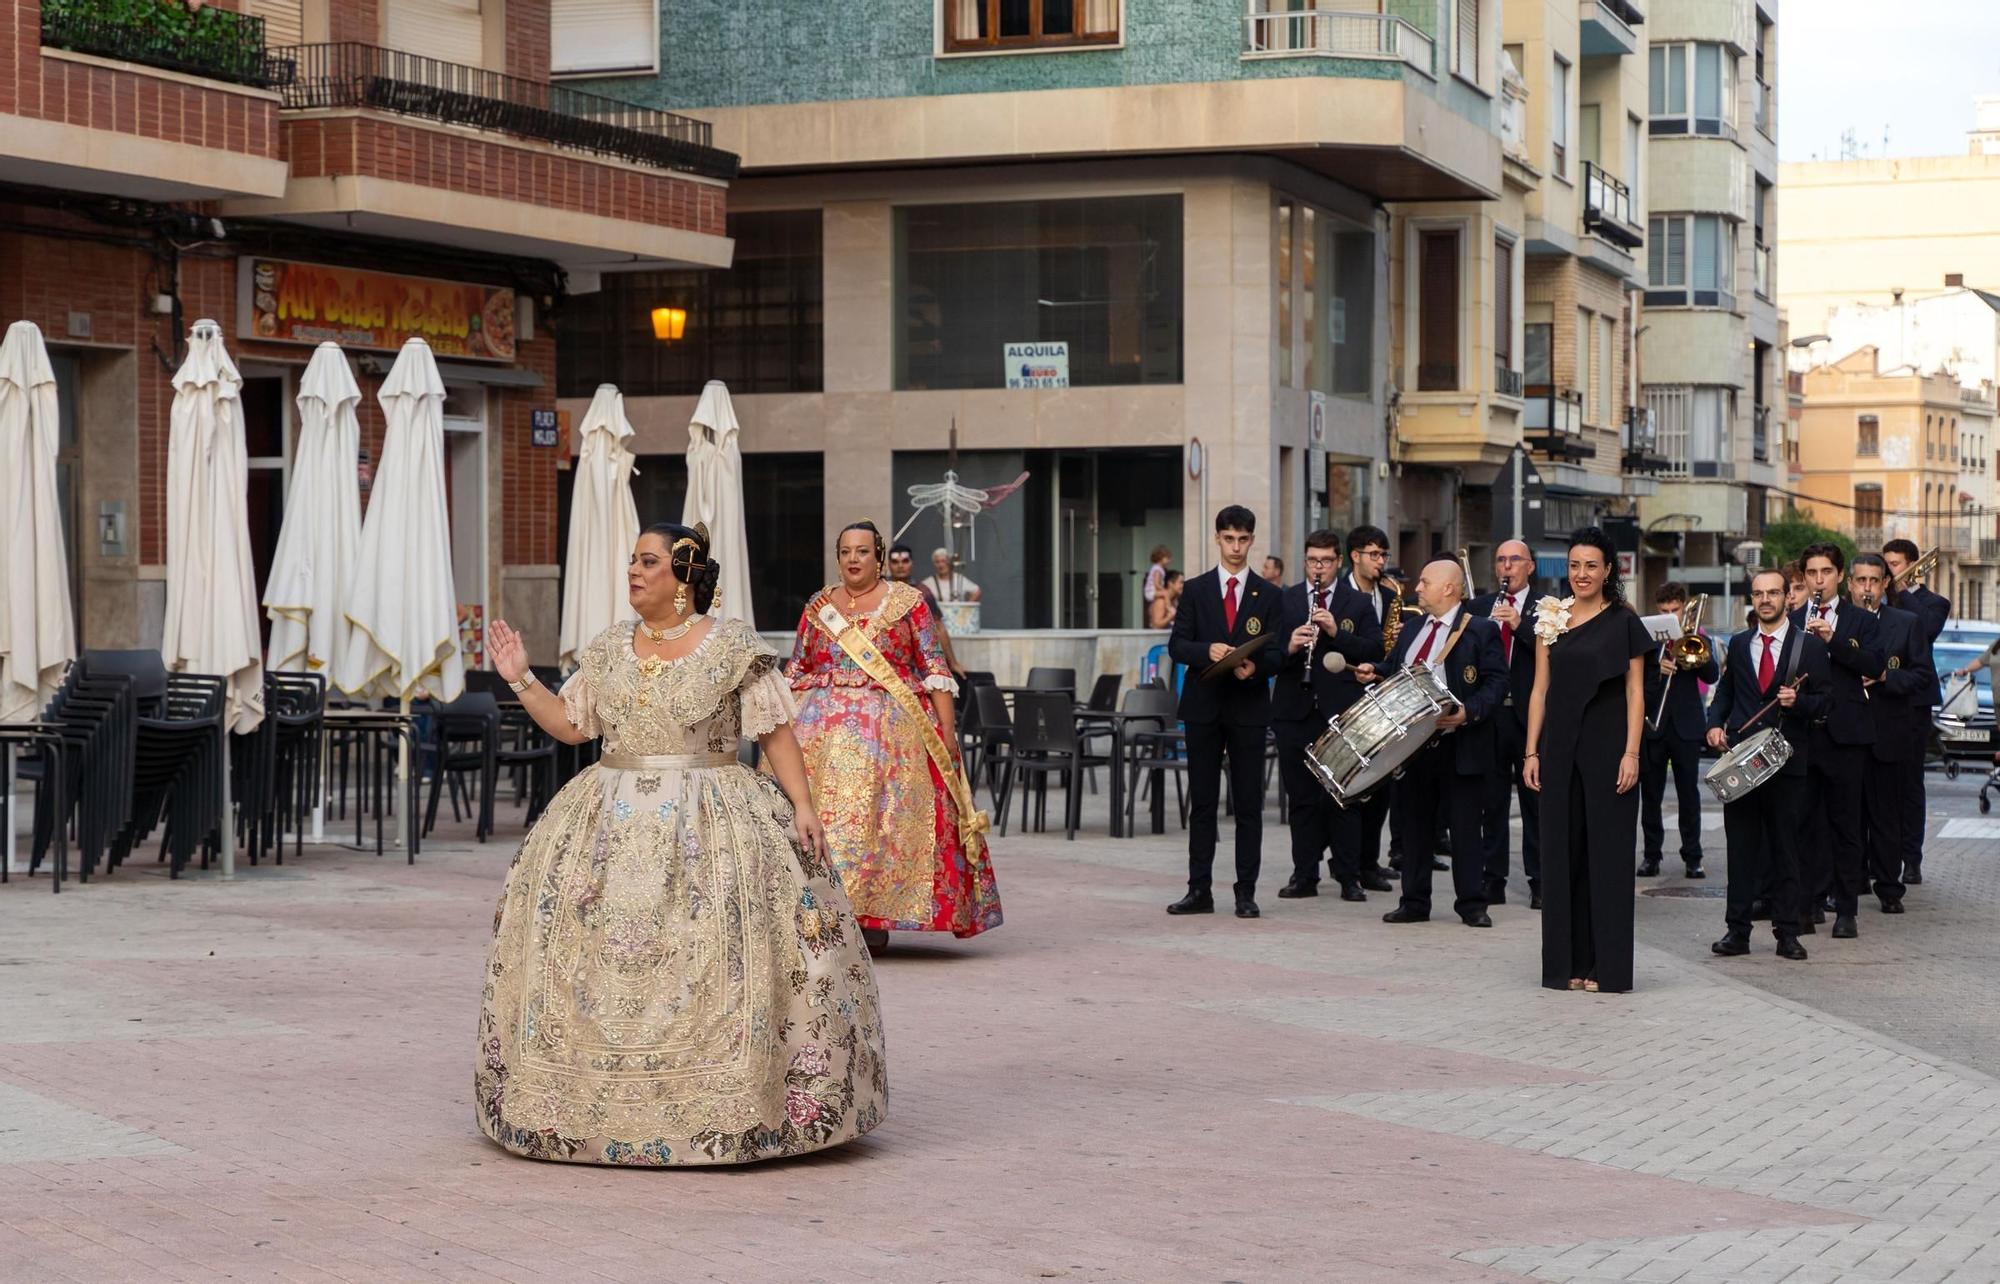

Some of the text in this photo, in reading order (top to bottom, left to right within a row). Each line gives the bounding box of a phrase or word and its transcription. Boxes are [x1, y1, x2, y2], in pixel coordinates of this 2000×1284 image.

[323, 276, 386, 329] Baba
[391, 283, 470, 339] Kebab
[1008, 345, 1065, 357] ALQUILA
